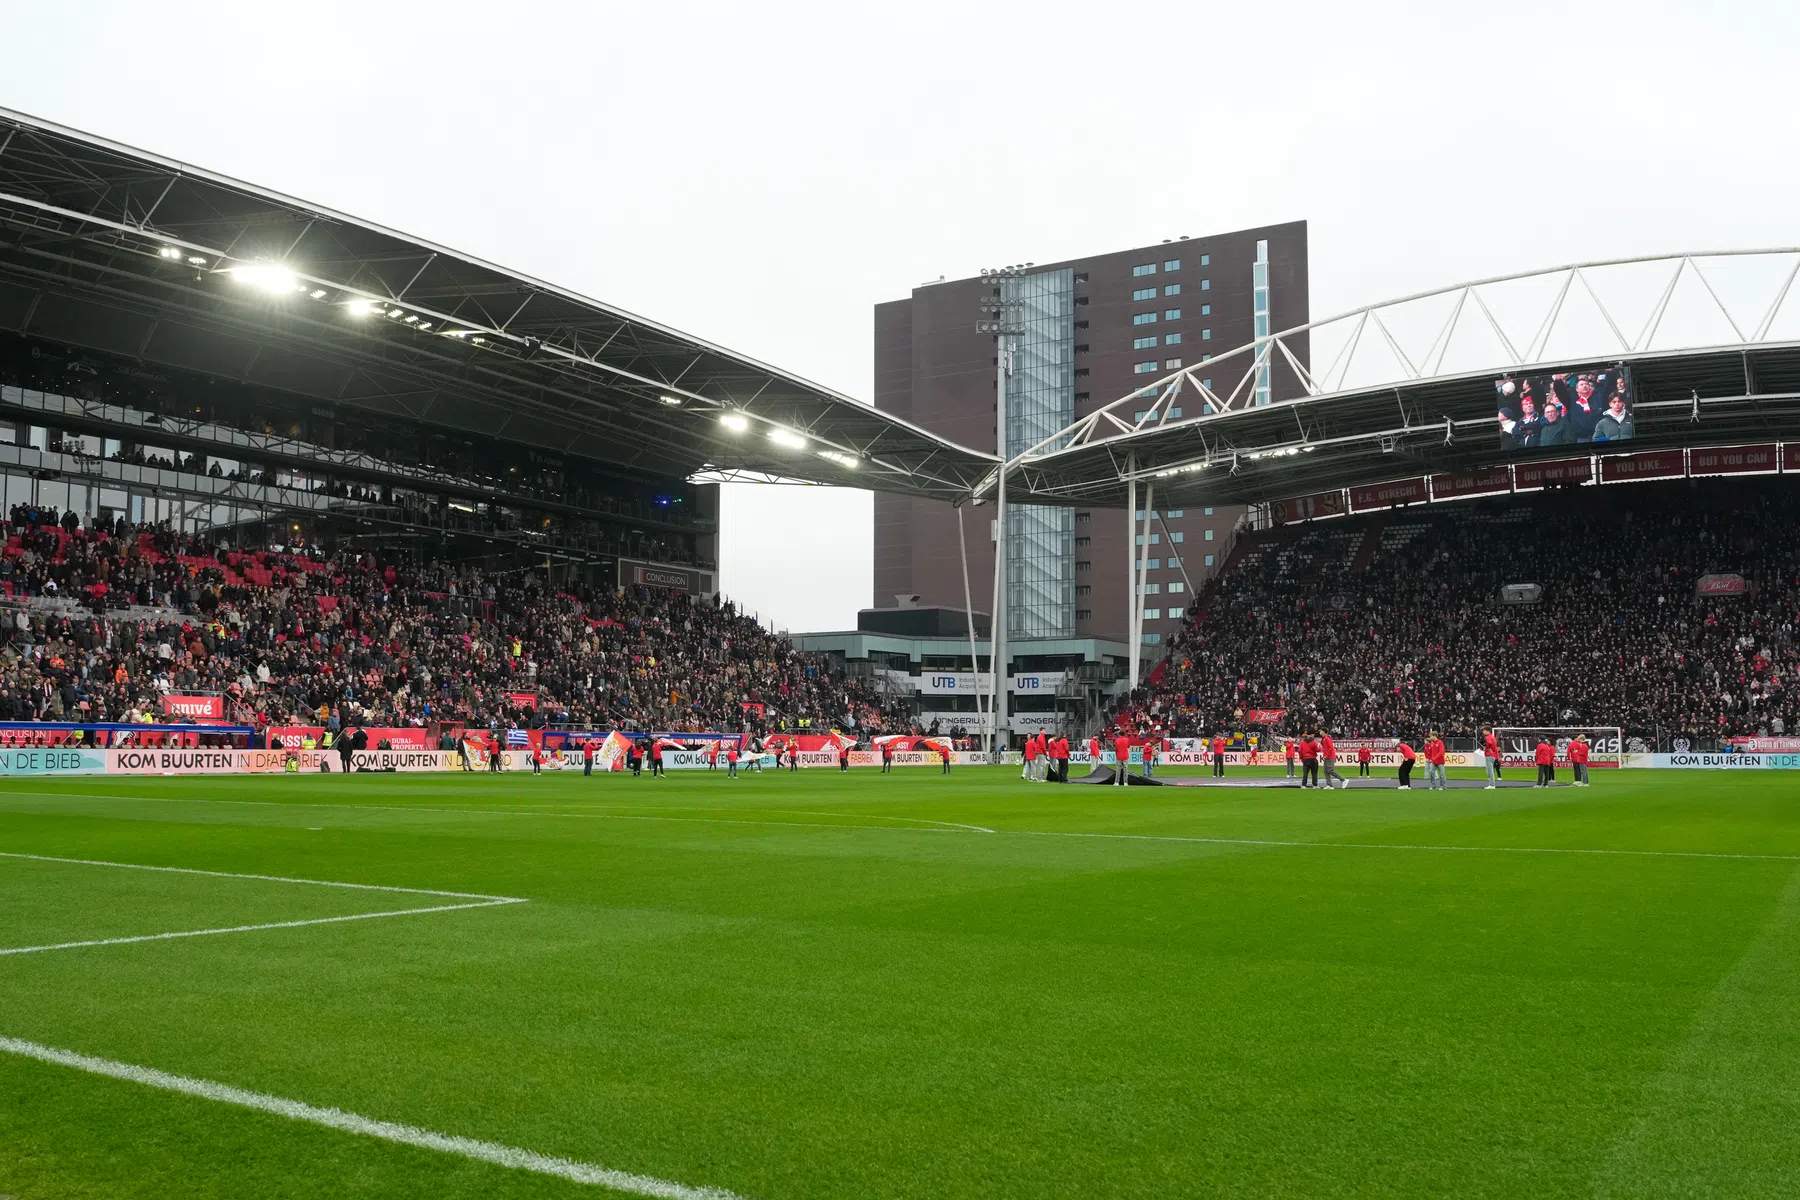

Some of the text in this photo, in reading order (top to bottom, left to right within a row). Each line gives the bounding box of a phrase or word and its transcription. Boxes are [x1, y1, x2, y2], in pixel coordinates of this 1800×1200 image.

[1699, 453, 1768, 467] BUT YOU CAN
[1524, 470, 1542, 481] OUT
[1568, 465, 1590, 476] TIME
[1615, 461, 1635, 473] YOU
[1434, 481, 1451, 492] YOU
[1456, 478, 1474, 488] CAN
[1378, 485, 1417, 500] UTRECHT
[646, 572, 686, 585] CONCLUSION
[932, 676, 956, 688] UTB
[1017, 677, 1039, 688] UTB
[171, 700, 212, 715] univé
[1260, 711, 1280, 720] Bud
[16, 753, 38, 769] DE
[45, 753, 81, 769] BIEB
[117, 753, 156, 769] KOM
[161, 753, 232, 768] BUURTEN
[237, 753, 250, 767] IN
[382, 754, 438, 767] BUURTEN
[441, 754, 452, 766] IN
[673, 754, 693, 764] KOM
[802, 754, 832, 763] BUURTEN
[851, 754, 874, 763] FABRIEK
[896, 754, 923, 762] BUURTEN
[1106, 754, 1115, 762] IN
[1169, 754, 1192, 762] KOM
[1670, 755, 1798, 766] KOM BUURTEN IN DE
